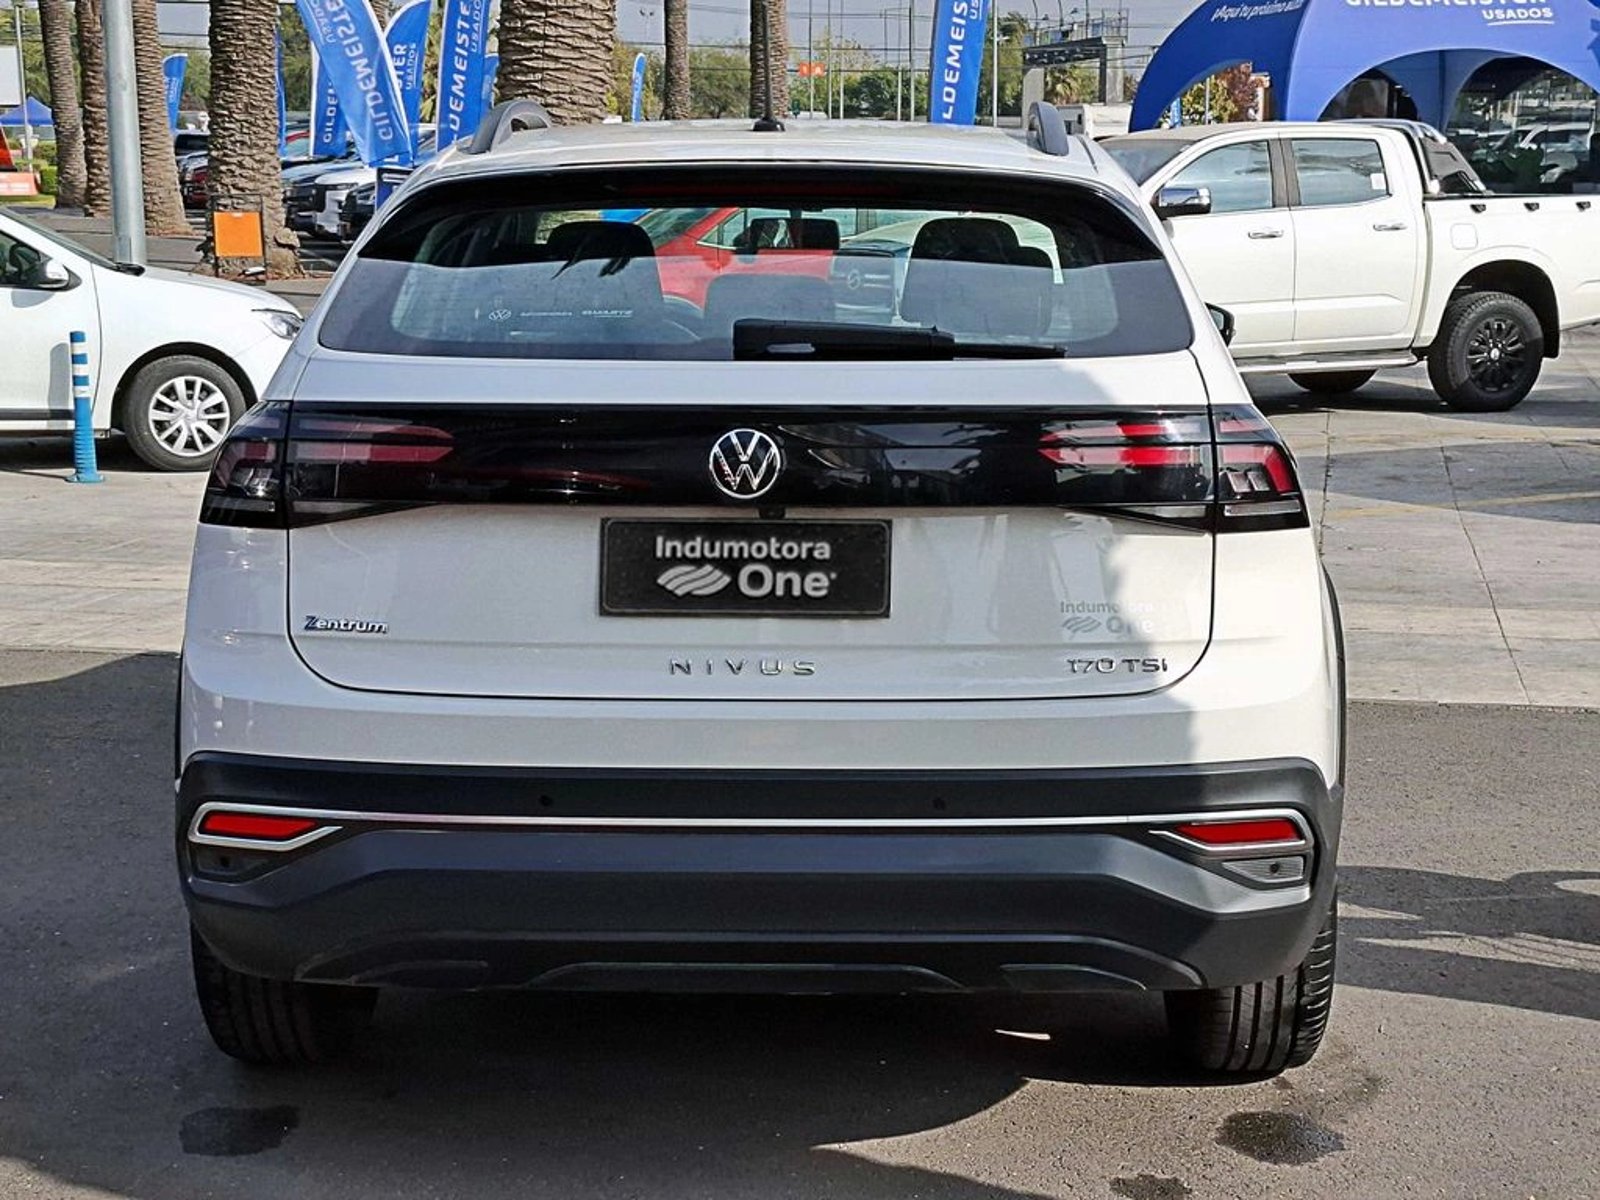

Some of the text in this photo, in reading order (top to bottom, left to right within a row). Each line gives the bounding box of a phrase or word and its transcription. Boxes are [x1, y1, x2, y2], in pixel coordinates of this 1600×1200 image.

[1482, 7, 1554, 20] USADOS
[655, 535, 832, 560] Indumotora
[737, 563, 831, 598] One
[303, 614, 388, 634] Zentrum
[669, 658, 817, 677] NIVUS
[1066, 656, 1116, 674] 170
